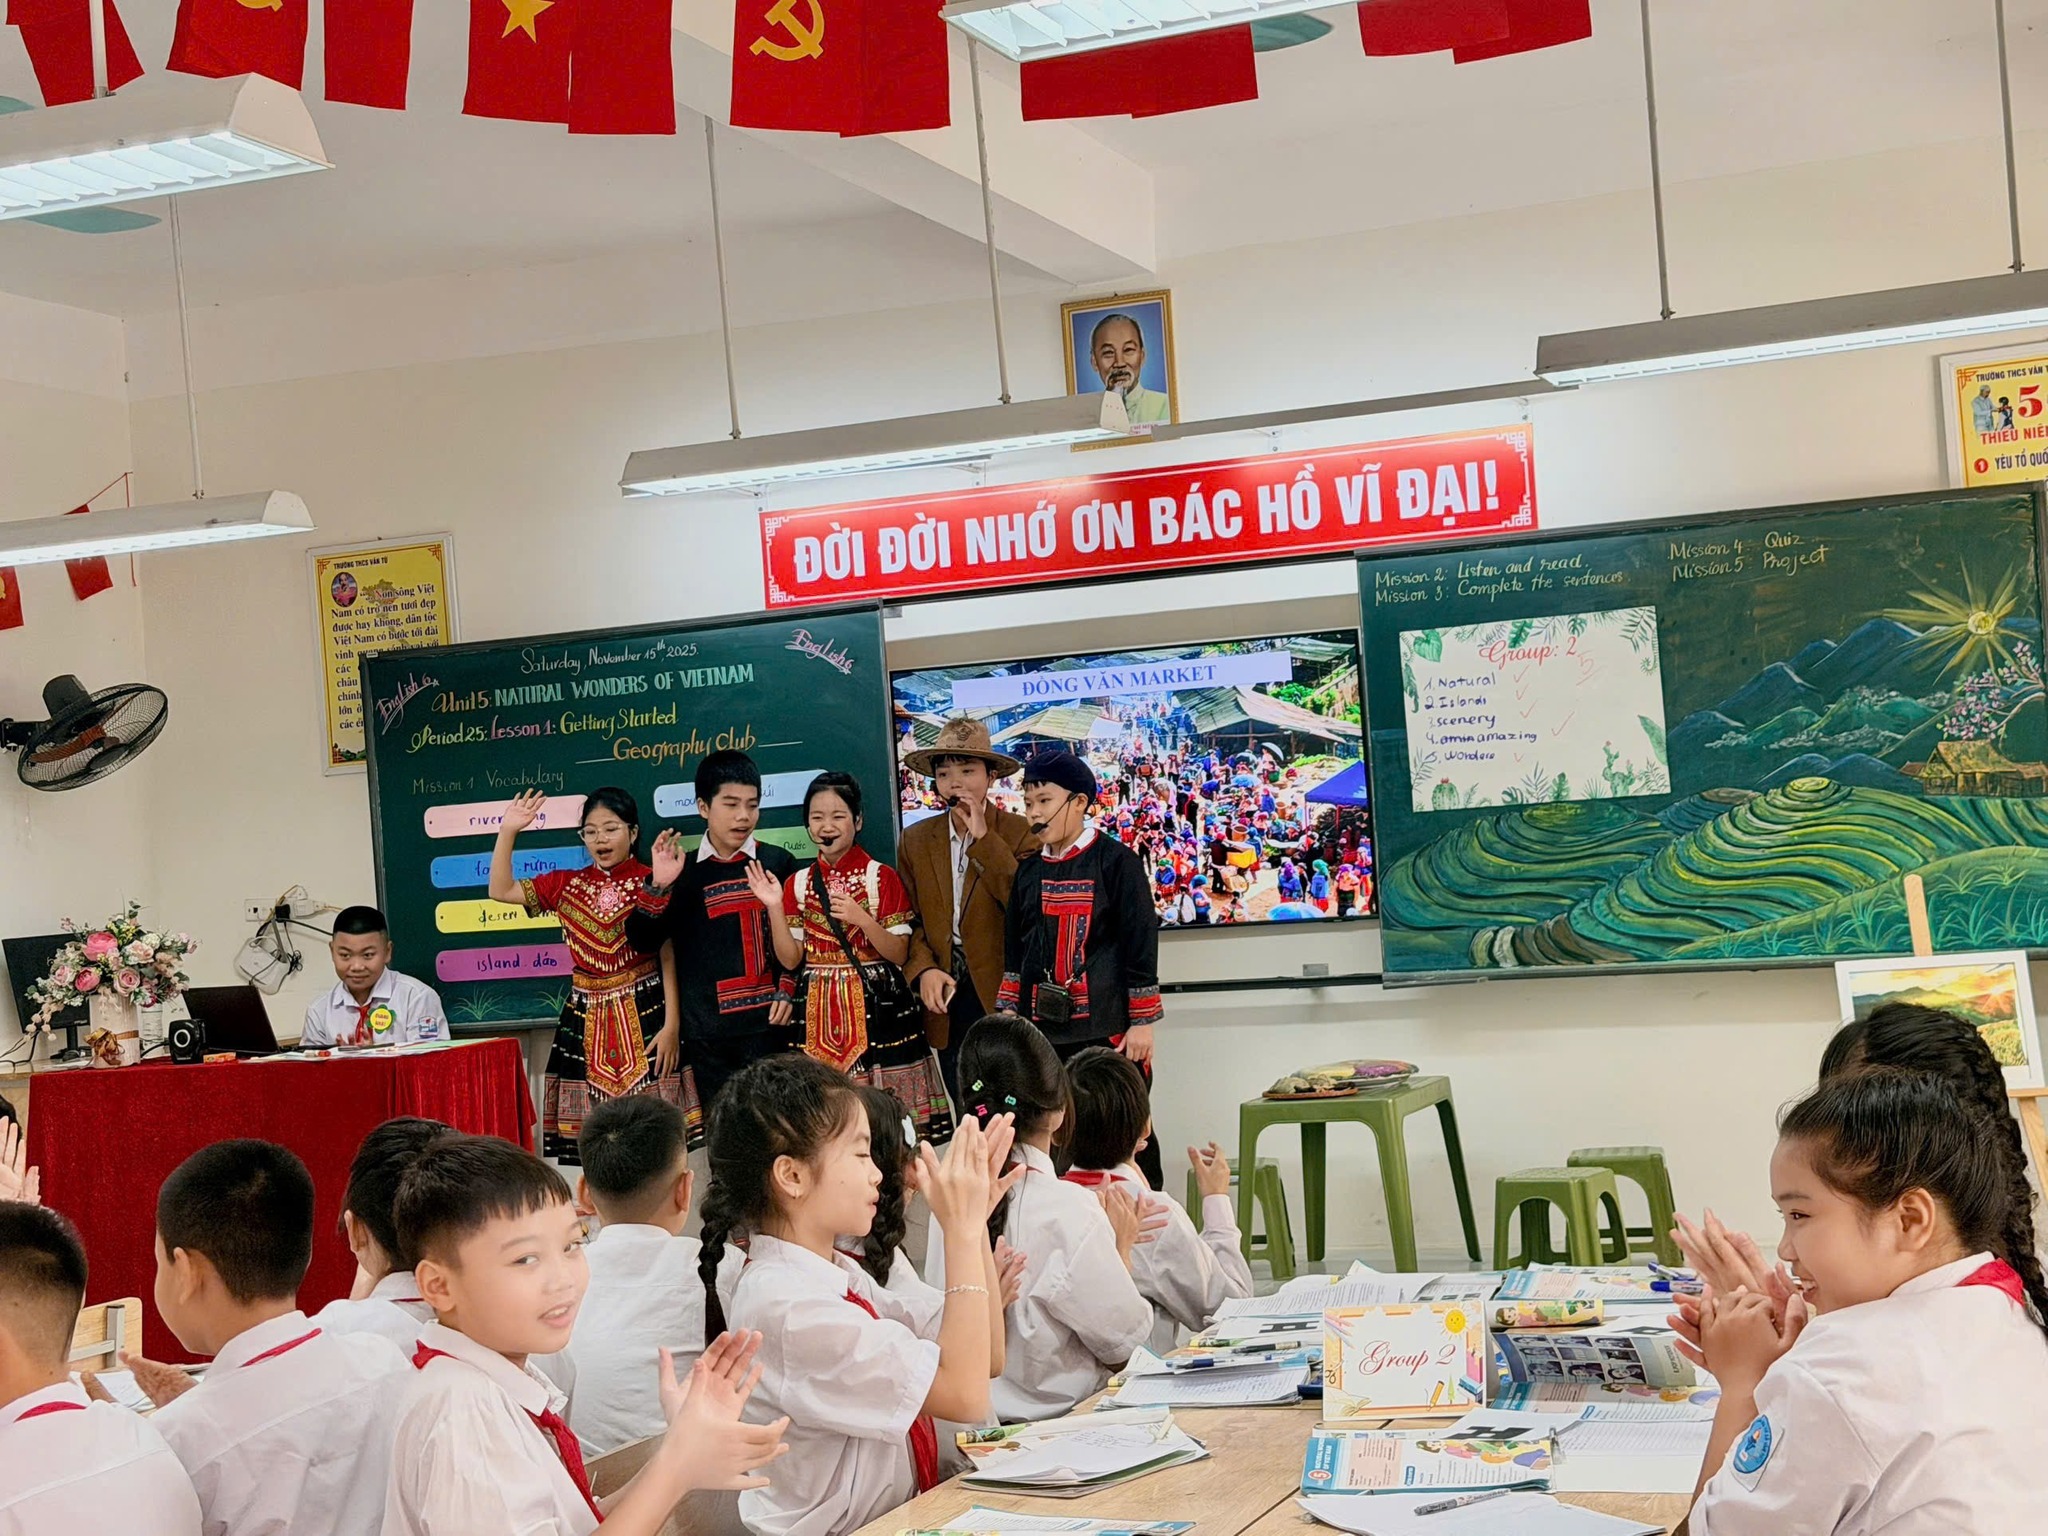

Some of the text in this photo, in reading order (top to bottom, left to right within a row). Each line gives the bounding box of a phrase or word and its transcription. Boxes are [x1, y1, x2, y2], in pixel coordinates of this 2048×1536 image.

[2007, 368, 2027, 378] THCS
[2018, 384, 2043, 418] 5
[2023, 423, 2048, 440] NIÊ
[1995, 453, 2012, 470] YÊU
[794, 457, 1499, 584] ĐỜI ĐỜI NHỚ ƠN BÁC HỒ VĨ ĐẠI!
[1670, 541, 1729, 560] Mission
[1765, 531, 1805, 549] Quiz
[356, 559, 368, 567] THCS
[1375, 571, 1430, 589] Mission
[1458, 561, 1501, 579] Listen
[1505, 556, 1534, 574] and
[1672, 563, 1732, 582] Mission
[1763, 544, 1829, 576] Project
[417, 584, 435, 596] Việt
[1375, 590, 1428, 606] Mission
[1458, 577, 1524, 603] Complete
[1531, 573, 1553, 592] the
[331, 608, 352, 618] Nam
[355, 606, 364, 616] có
[382, 602, 398, 612] nên
[401, 600, 418, 611] tươi
[420, 598, 436, 610] đẹp
[332, 623, 353, 633] được
[356, 621, 370, 631] hay
[405, 614, 422, 624] dân
[424, 612, 437, 623] tộc
[334, 635, 352, 647] Việt
[354, 634, 375, 644] Nam
[377, 632, 387, 642] có
[425, 625, 439, 636] đài
[335, 649, 354, 659] vinh
[589, 645, 641, 666] November
[1479, 636, 1577, 670] Group: 2
[336, 664, 351, 674] các
[421, 673, 431, 685] 6
[1085, 667, 1125, 691] VĂN
[1129, 664, 1217, 688] MARKET
[337, 677, 358, 687] châu
[432, 691, 475, 712] Unit
[495, 684, 564, 706] NATURAL
[571, 674, 649, 699] WONDERS
[654, 671, 674, 690] OF
[679, 663, 754, 688] VIETNAM
[1438, 672, 1496, 688] Natural
[339, 705, 352, 715] lớn
[340, 719, 354, 729] các
[405, 722, 464, 753] Period
[490, 715, 541, 740] Lesson
[560, 711, 615, 741] Getting
[617, 702, 679, 729] Started
[1437, 714, 1496, 729] scenery
[613, 724, 756, 769] Geography Club
[412, 779, 462, 796] Mission
[486, 764, 564, 792] Vocabulary
[469, 815, 503, 826] river
[477, 953, 520, 972] island
[1359, 1340, 1457, 1376] Group 2
